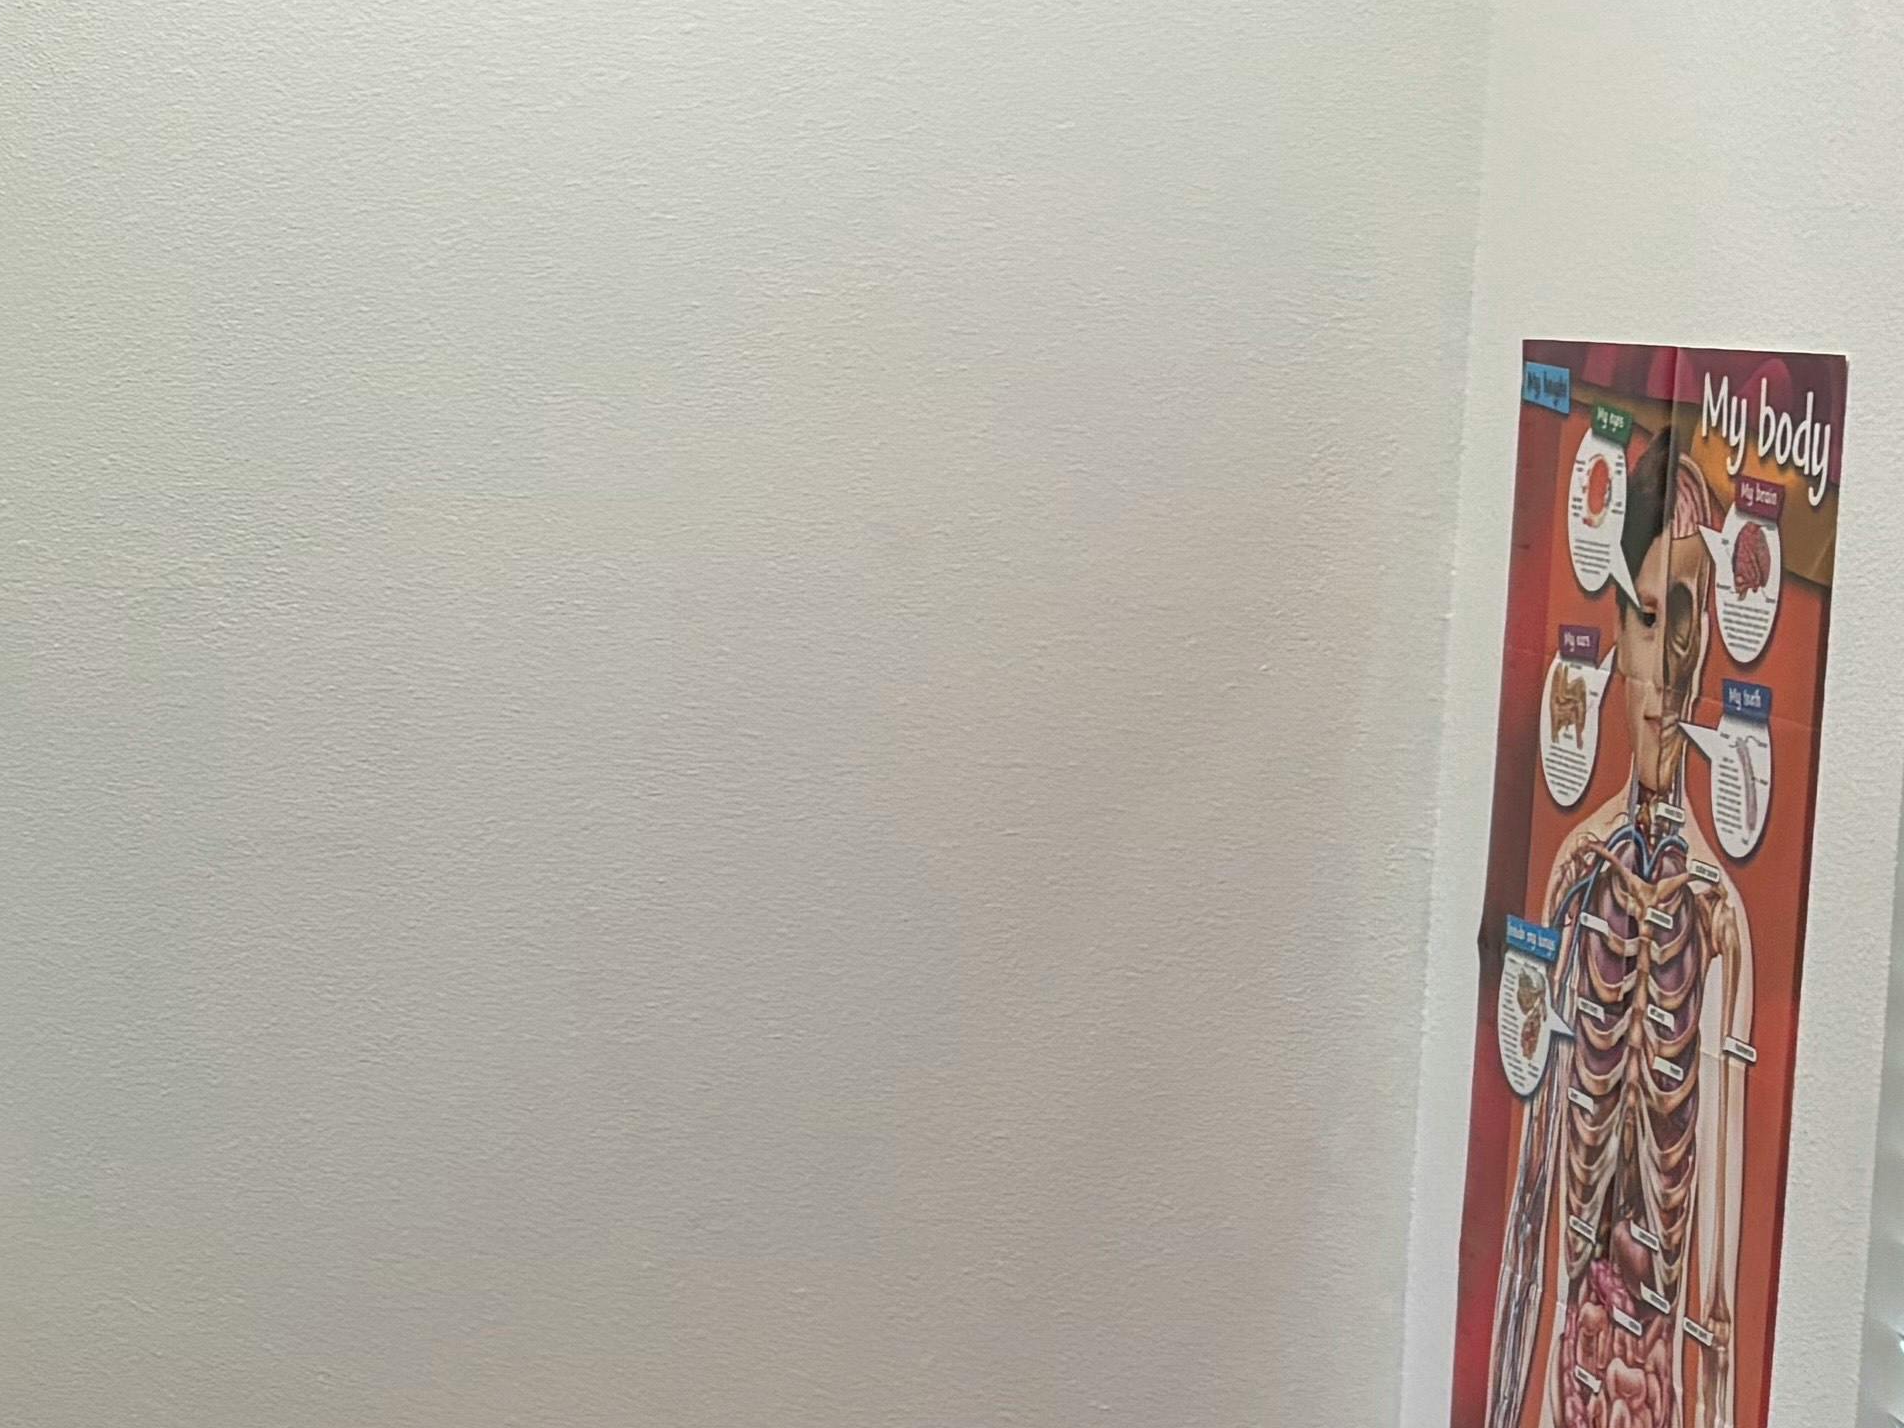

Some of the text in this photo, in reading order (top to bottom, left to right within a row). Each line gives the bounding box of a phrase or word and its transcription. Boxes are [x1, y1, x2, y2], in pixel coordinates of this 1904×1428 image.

[1701, 372, 1831, 507] My body
[1740, 482, 1754, 507] My
